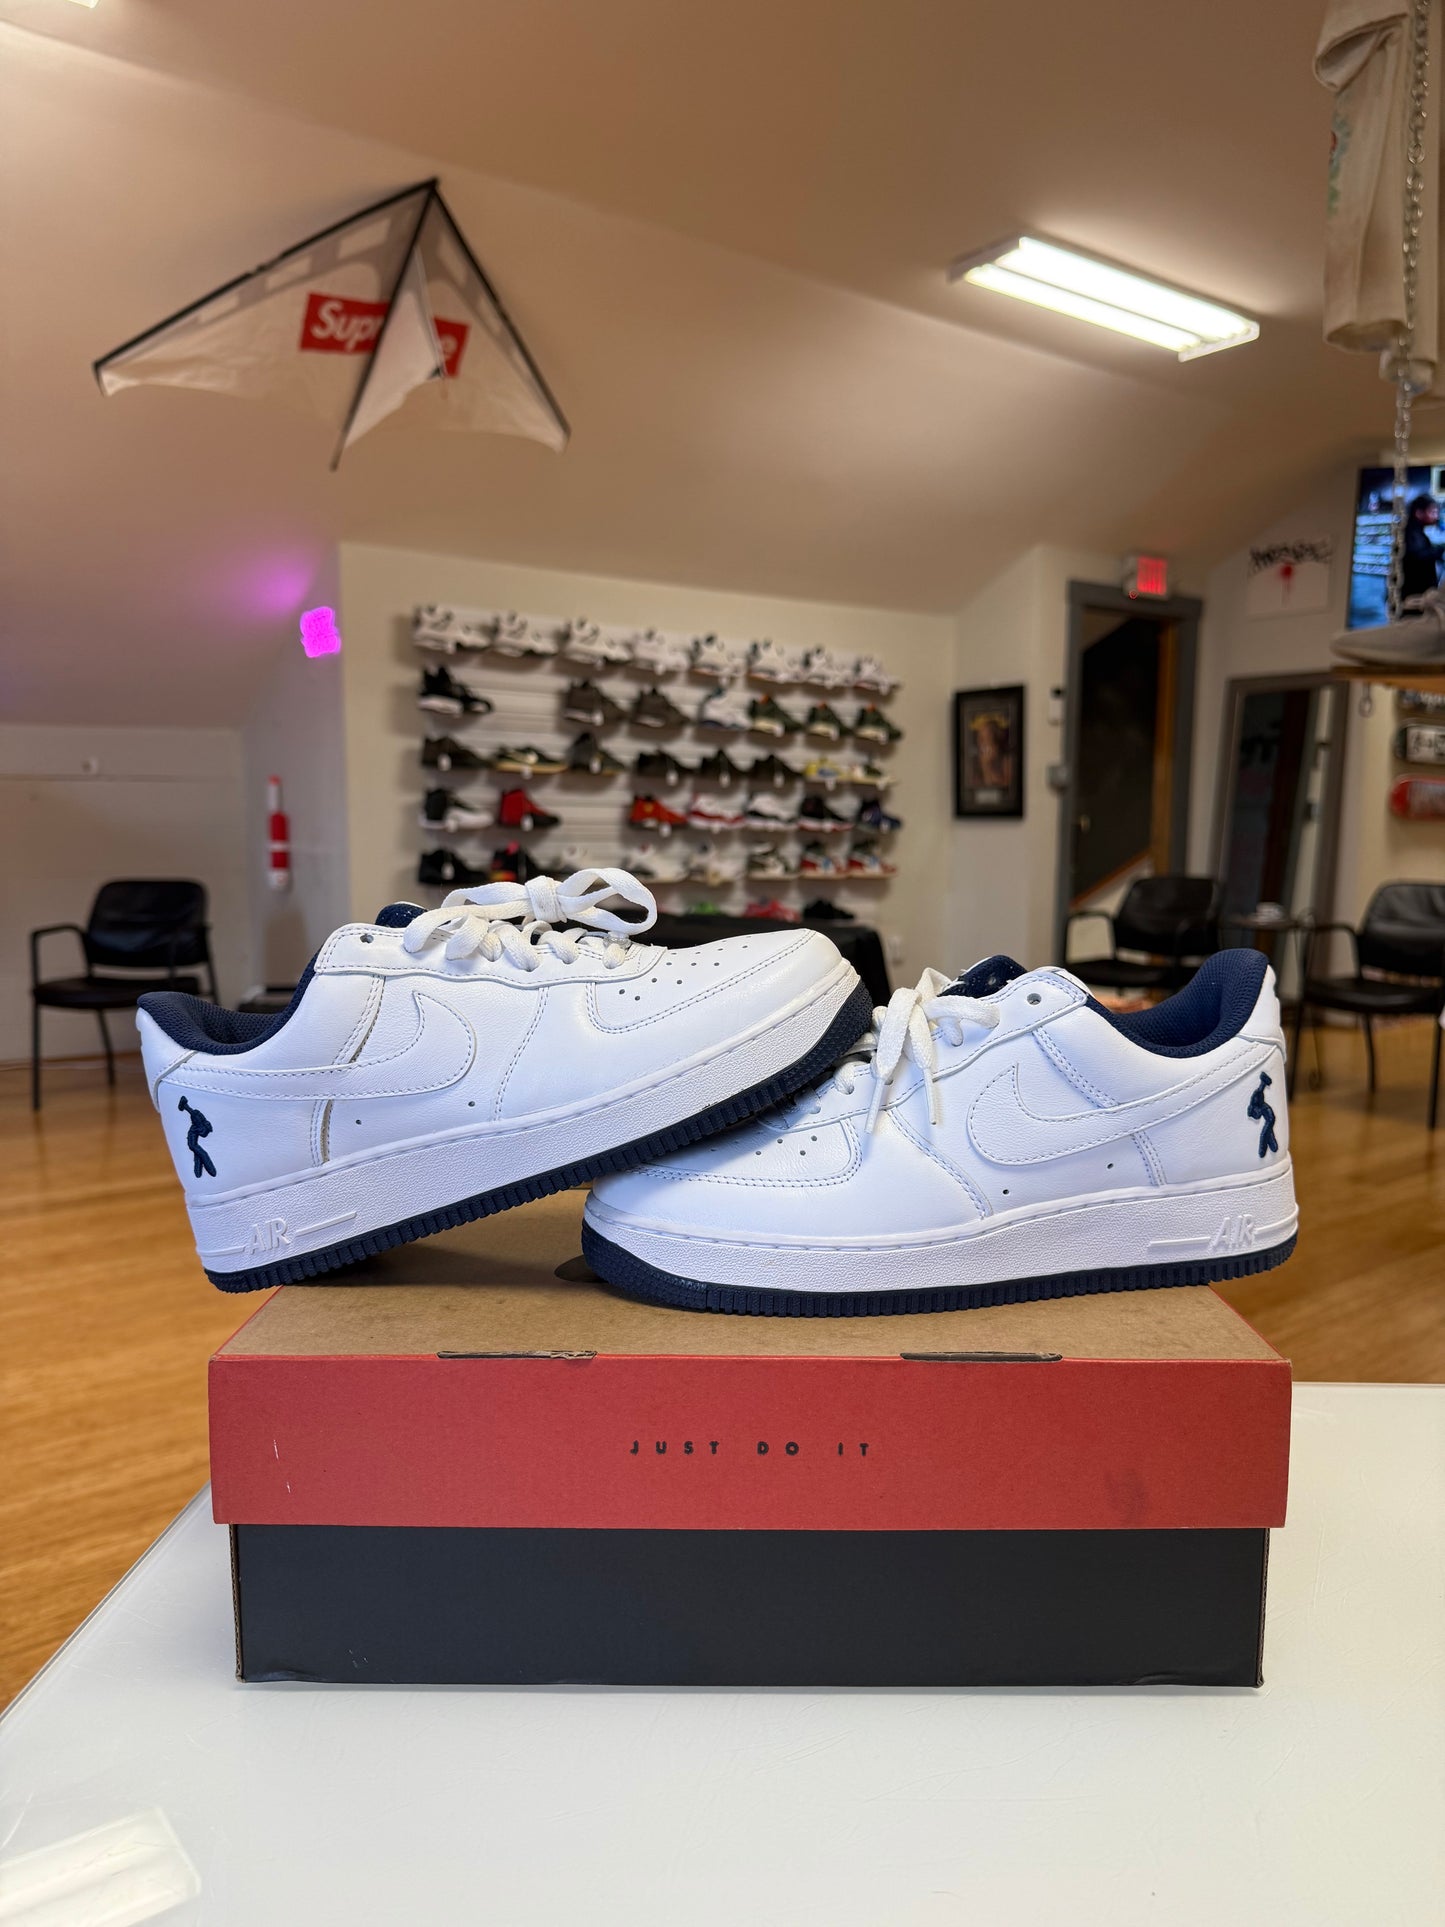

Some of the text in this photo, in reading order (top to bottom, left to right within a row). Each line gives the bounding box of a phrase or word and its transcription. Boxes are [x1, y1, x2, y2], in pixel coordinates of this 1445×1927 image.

[250, 1217, 291, 1255] AIR
[1207, 1213, 1255, 1255] AIR
[629, 1440, 870, 1456] JUST DO IT
